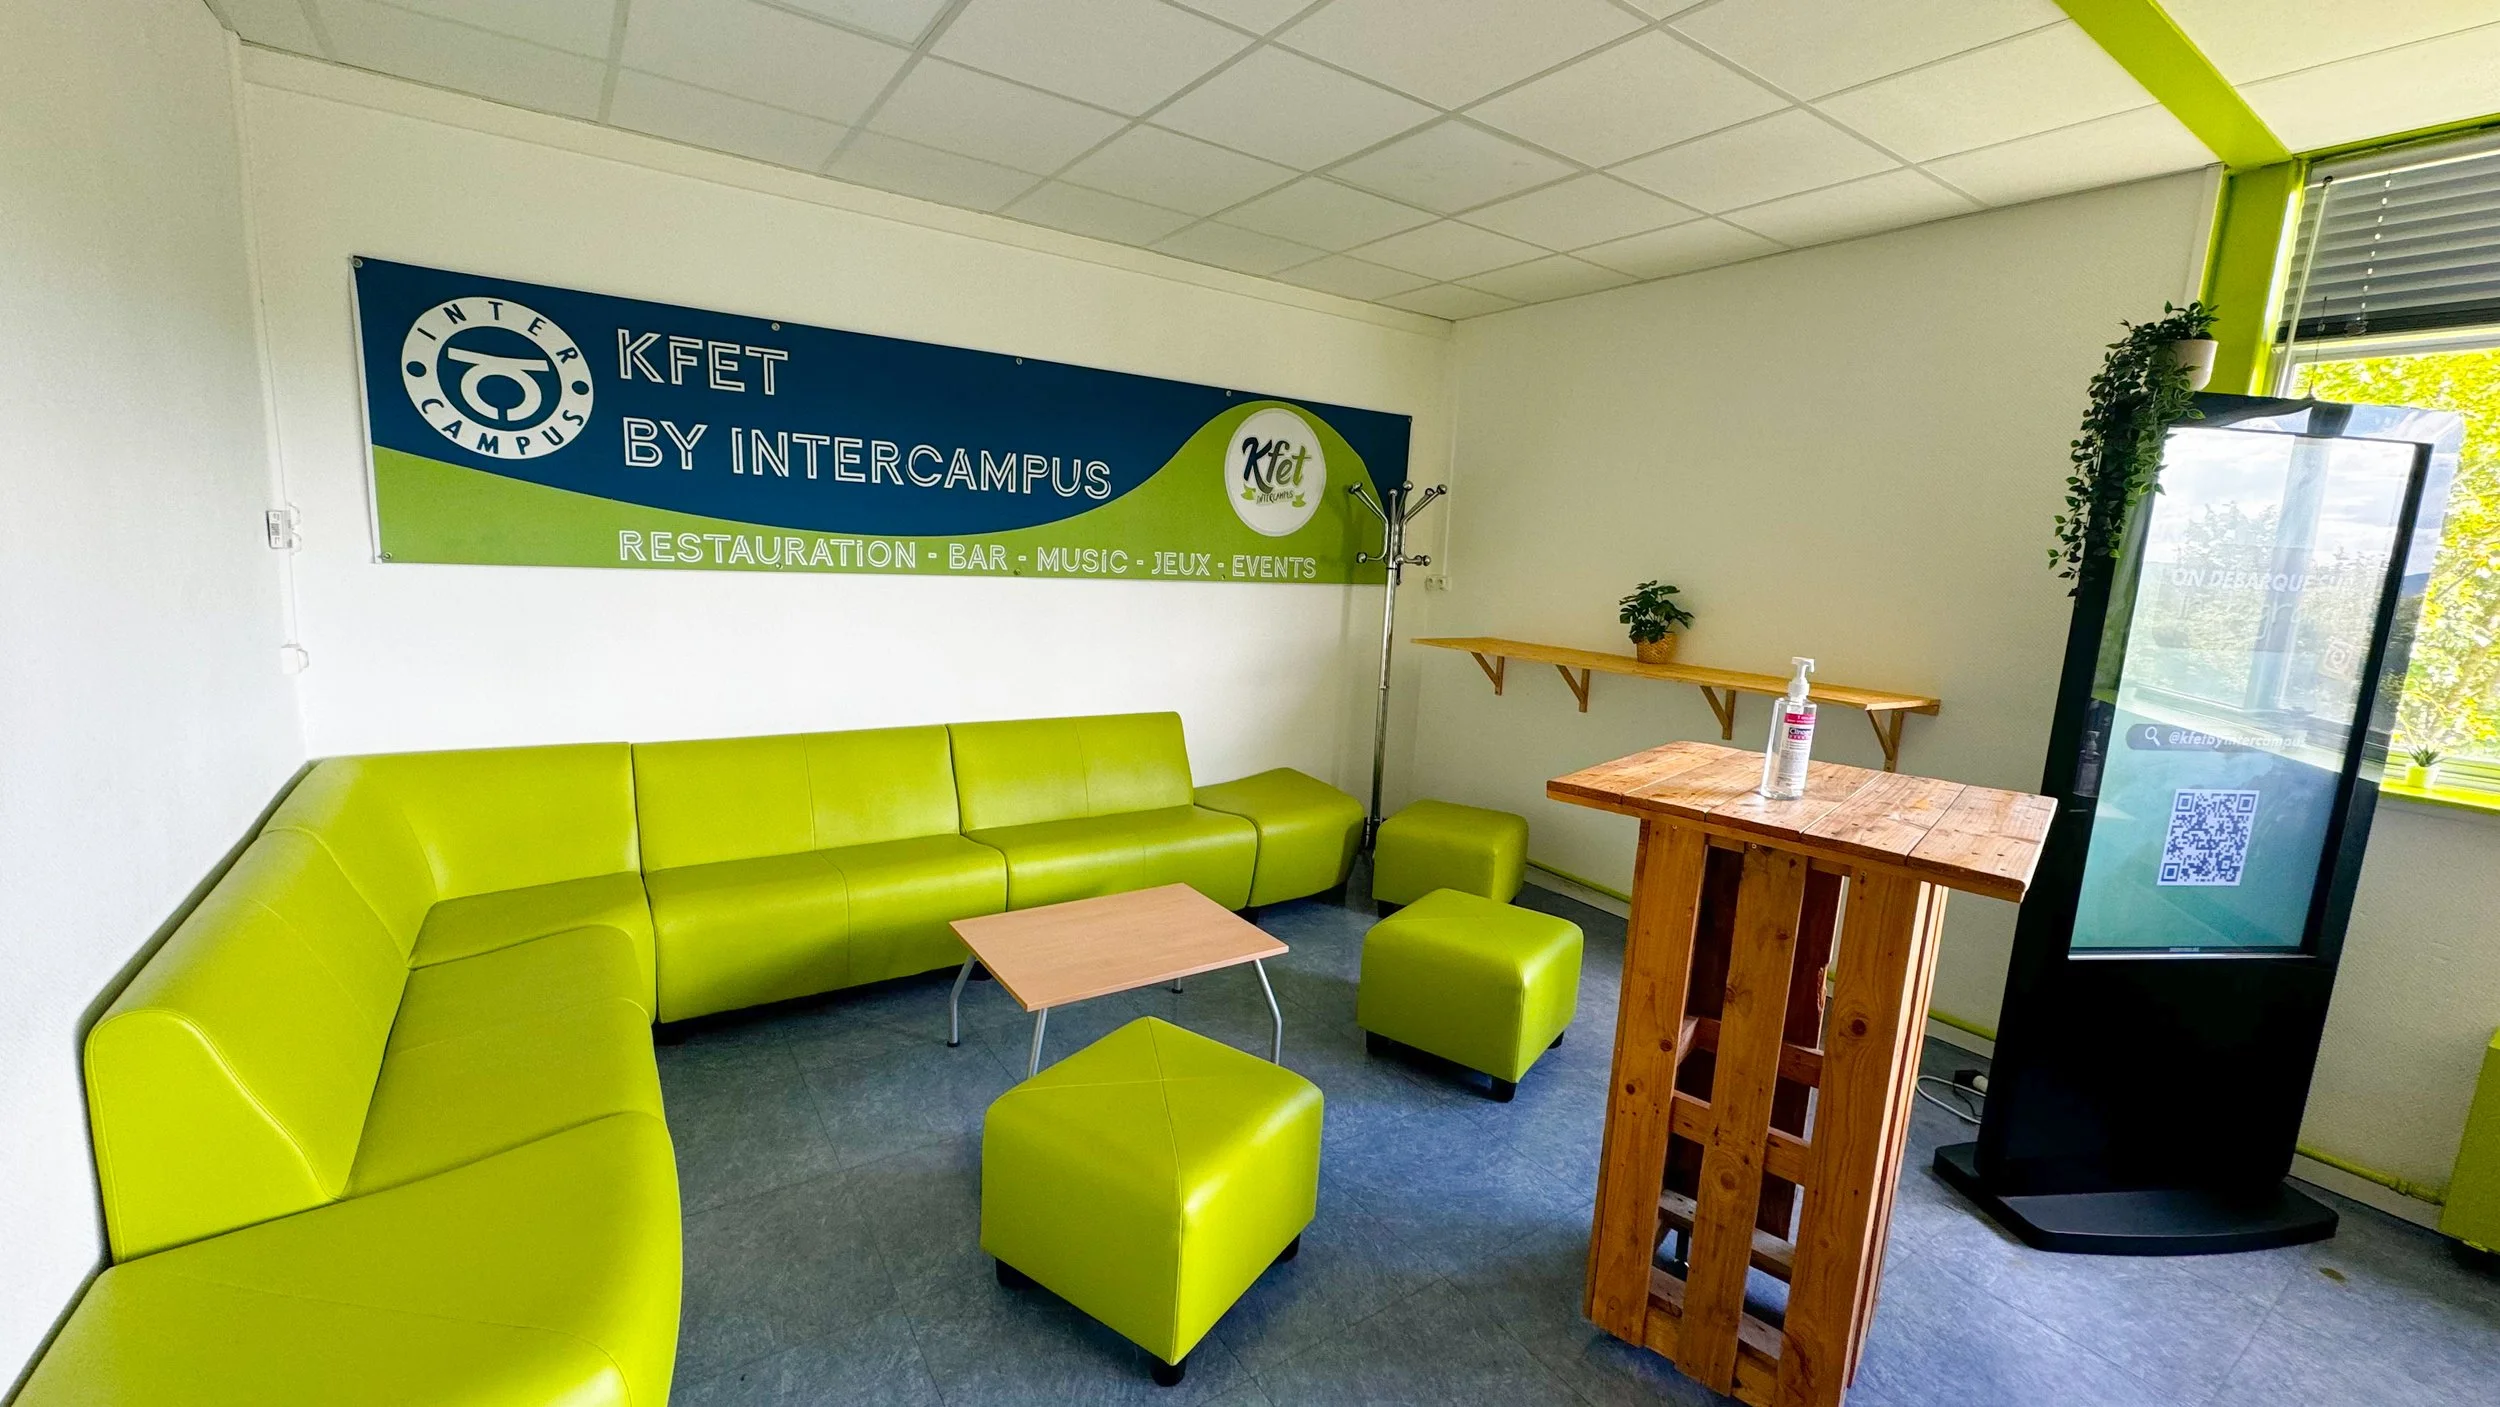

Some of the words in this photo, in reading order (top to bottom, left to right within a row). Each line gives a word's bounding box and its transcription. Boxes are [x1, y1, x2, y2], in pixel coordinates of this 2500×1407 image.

[416, 301, 579, 365] INTER
[617, 328, 789, 396] KFET
[421, 397, 585, 456] CAMPUS
[622, 416, 709, 471] BY
[731, 426, 1113, 500] INTERCAMPUS
[1241, 436, 1312, 494] Kfet
[618, 529, 916, 569] RESTAURATION
[949, 543, 1008, 570] BAR
[1037, 546, 1129, 574] MUSIC
[1151, 551, 1211, 577] JEUX
[1232, 554, 1317, 580] EVENTS
